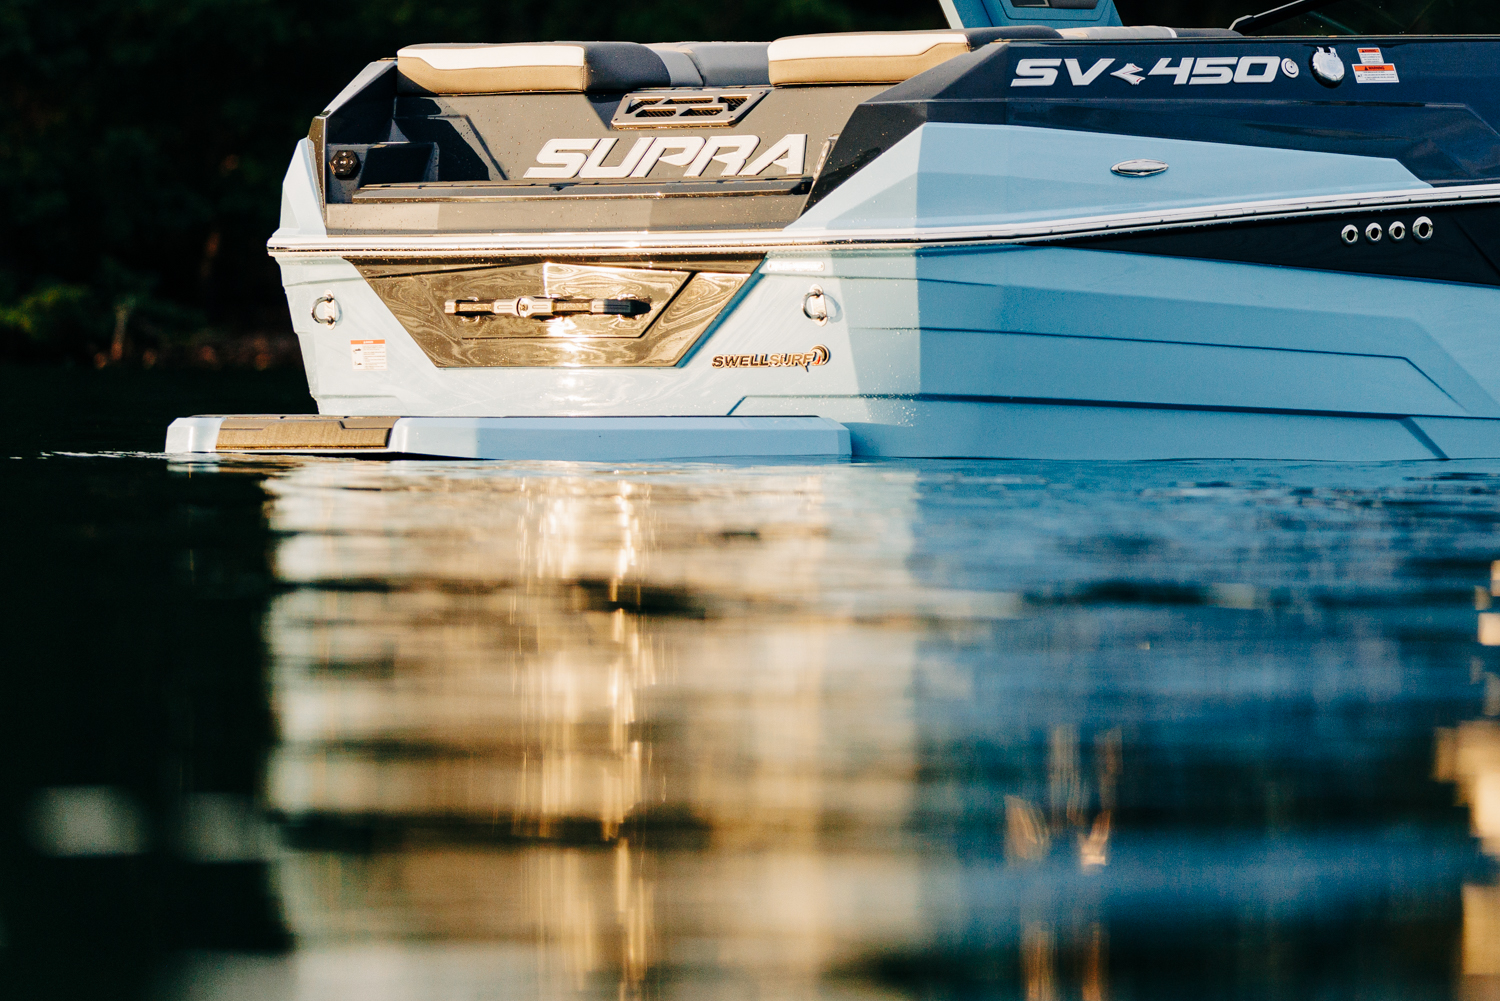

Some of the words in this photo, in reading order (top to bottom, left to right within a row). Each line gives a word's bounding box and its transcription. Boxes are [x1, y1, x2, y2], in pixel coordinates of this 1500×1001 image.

[1010, 58, 1116, 87] SV
[1148, 56, 1281, 86] 450
[523, 133, 808, 179] SUPRA
[711, 353, 815, 372] SWELLSURF
